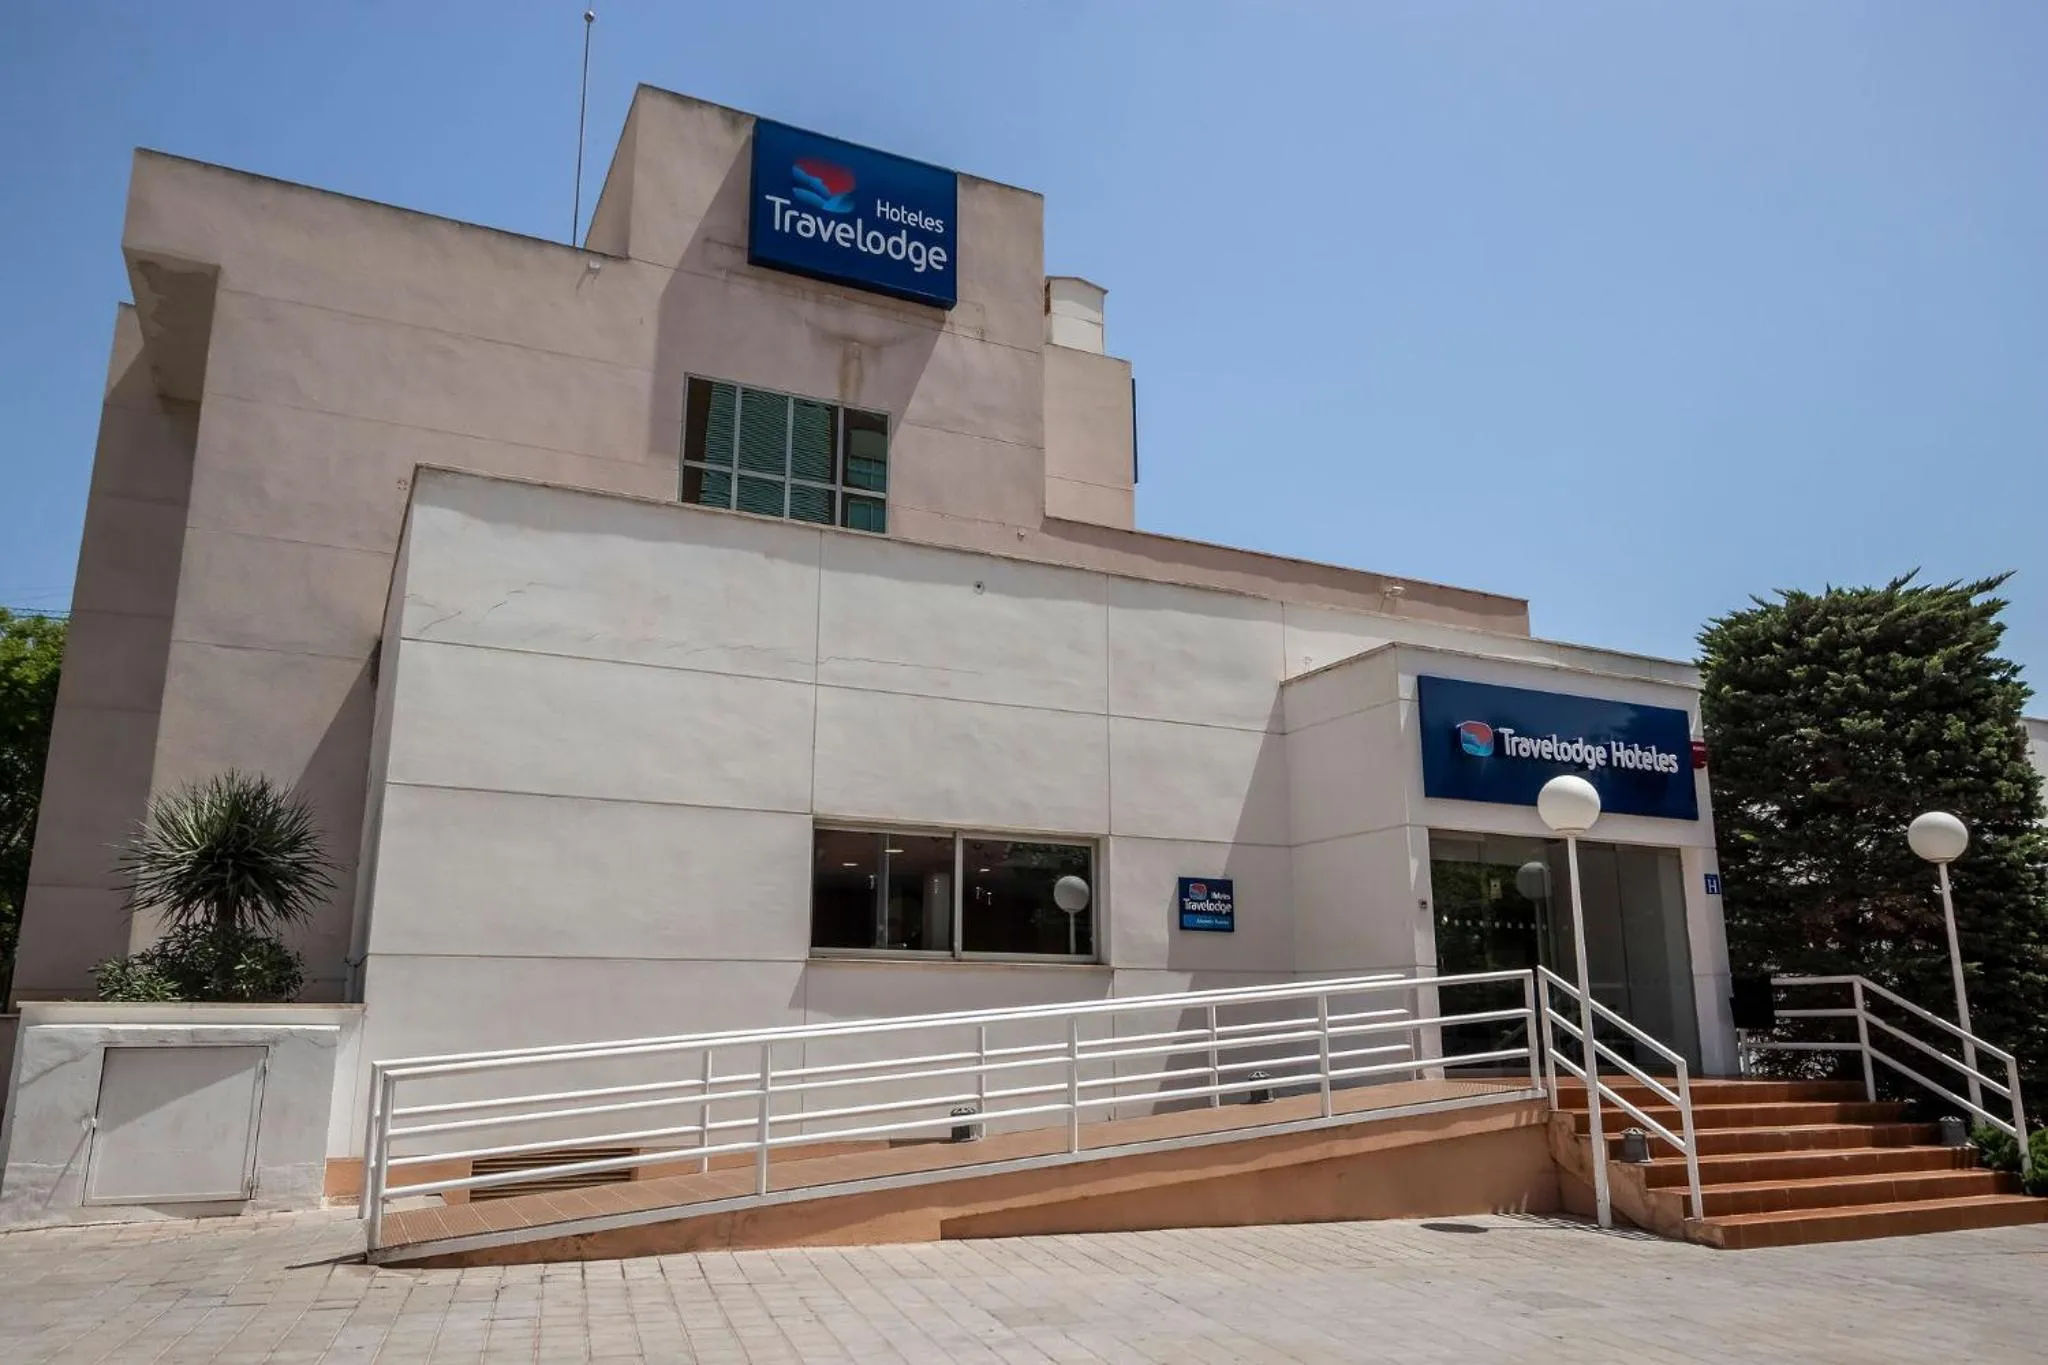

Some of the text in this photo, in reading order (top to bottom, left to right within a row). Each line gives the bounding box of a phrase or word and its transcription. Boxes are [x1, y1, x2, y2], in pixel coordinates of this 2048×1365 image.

[765, 194, 947, 272] Travelodge
[876, 198, 944, 233] Hoteles
[1498, 727, 1678, 773] Travelodge Hoteles
[1708, 878, 1717, 893] H
[1183, 898, 1232, 914] Travelodge
